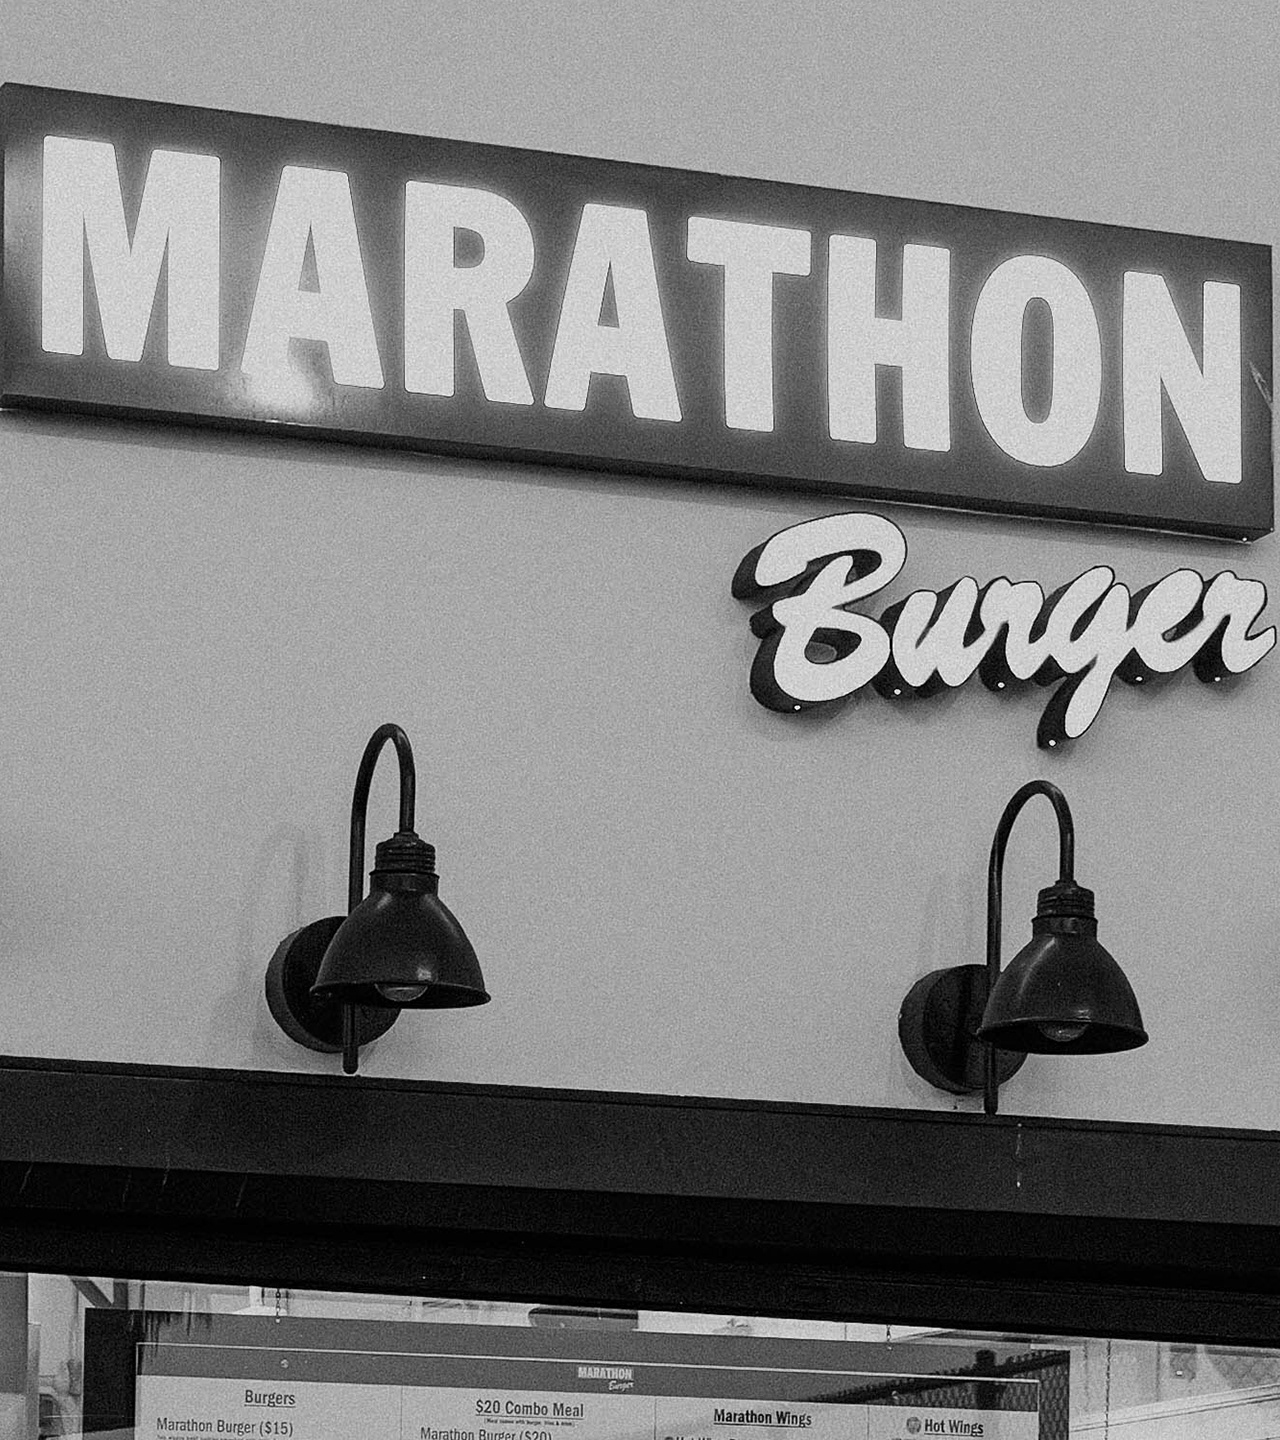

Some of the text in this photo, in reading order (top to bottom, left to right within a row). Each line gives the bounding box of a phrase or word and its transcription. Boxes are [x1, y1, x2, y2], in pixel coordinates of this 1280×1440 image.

[42, 134, 1243, 486] MARATHON
[734, 511, 1279, 747] Burger
[578, 1367, 633, 1379] MARATHON
[244, 1389, 296, 1407] Burgers
[476, 1399, 584, 1417] $20 Combo Meal
[157, 1417, 293, 1436] Marathon Burger ($15)
[714, 1409, 812, 1427] Marathon Wings
[925, 1419, 984, 1435] Hot Wings
